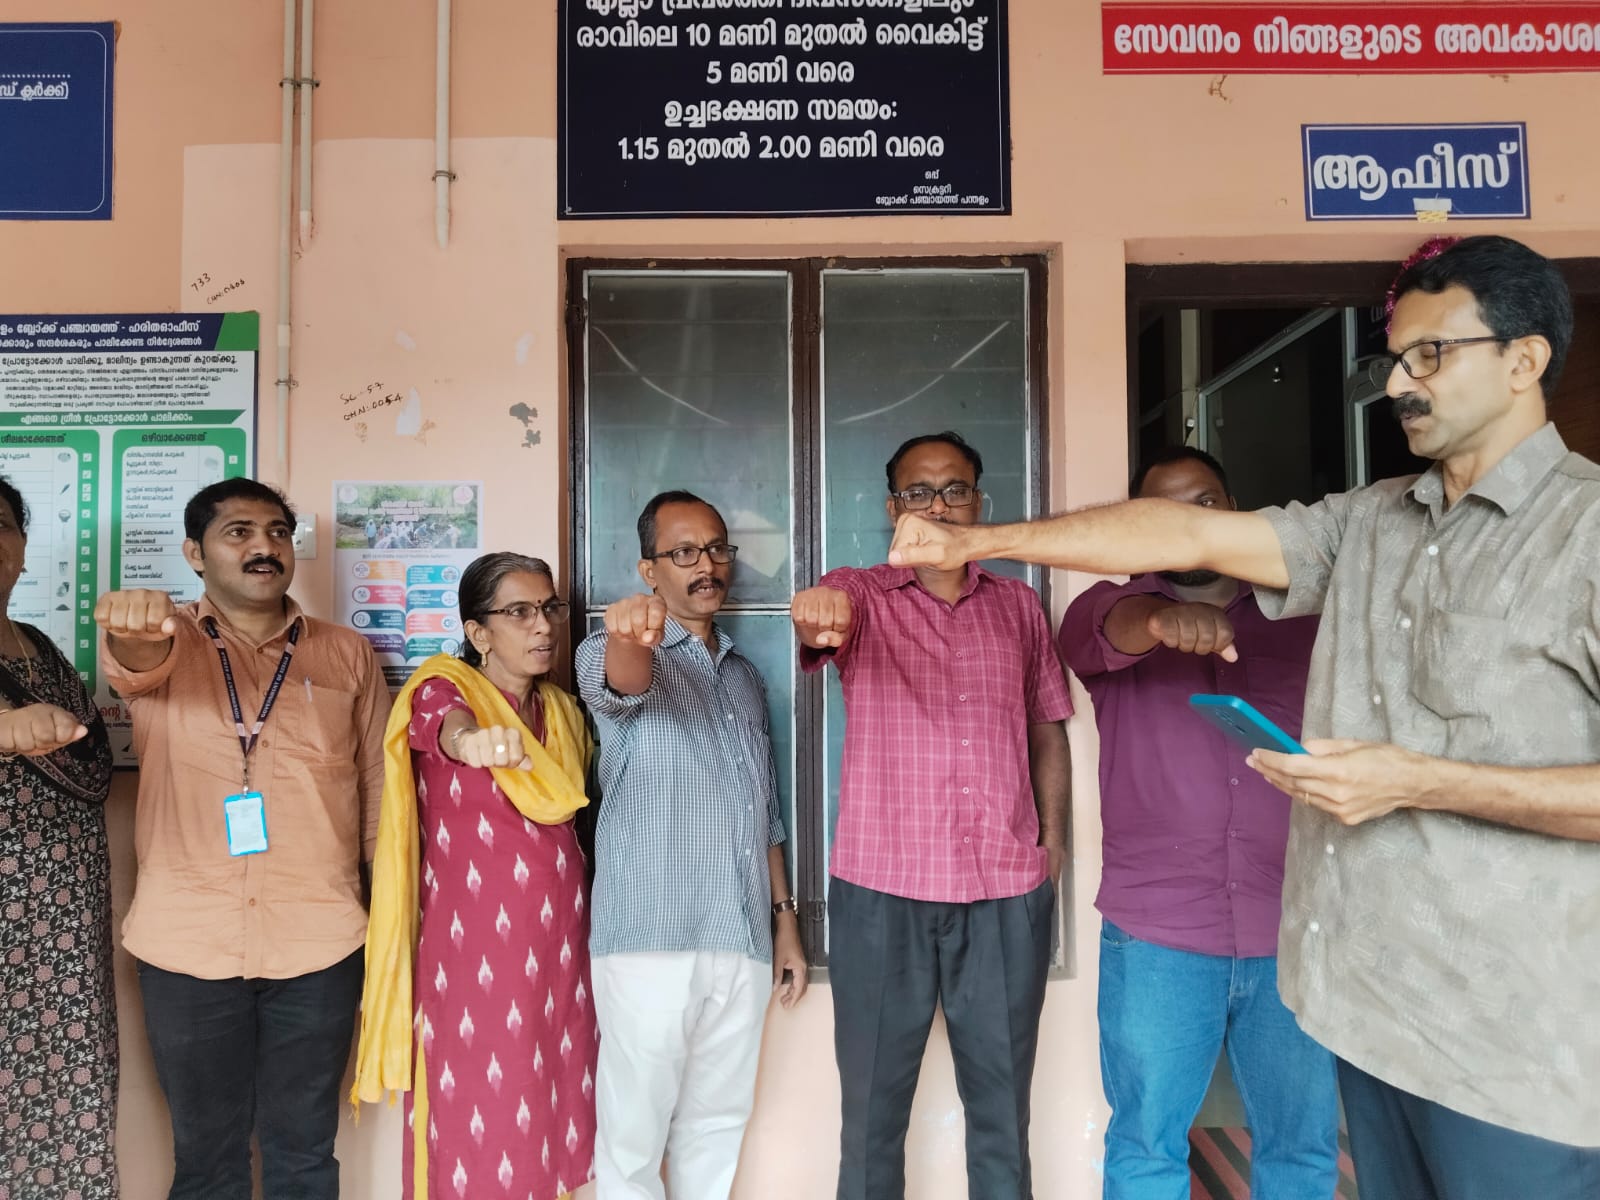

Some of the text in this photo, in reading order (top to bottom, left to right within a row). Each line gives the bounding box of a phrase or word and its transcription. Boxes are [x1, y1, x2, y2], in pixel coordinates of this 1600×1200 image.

[577, 16, 988, 52] രാവിലെ 10 മണി മുതൽ വൈകിട്ട്
[1114, 23, 1240, 55] സേവനം
[1253, 16, 1421, 61] നിങ്ങളുടെ
[706, 55, 855, 84] 5 മണി വരെ
[664, 99, 898, 128] ഉച്ചഭക്ഷണ സമയം:
[618, 130, 945, 166] 1.15 മുതൽ 2.00 മണി വരെ
[1312, 141, 1518, 201] ആഫീസ്
